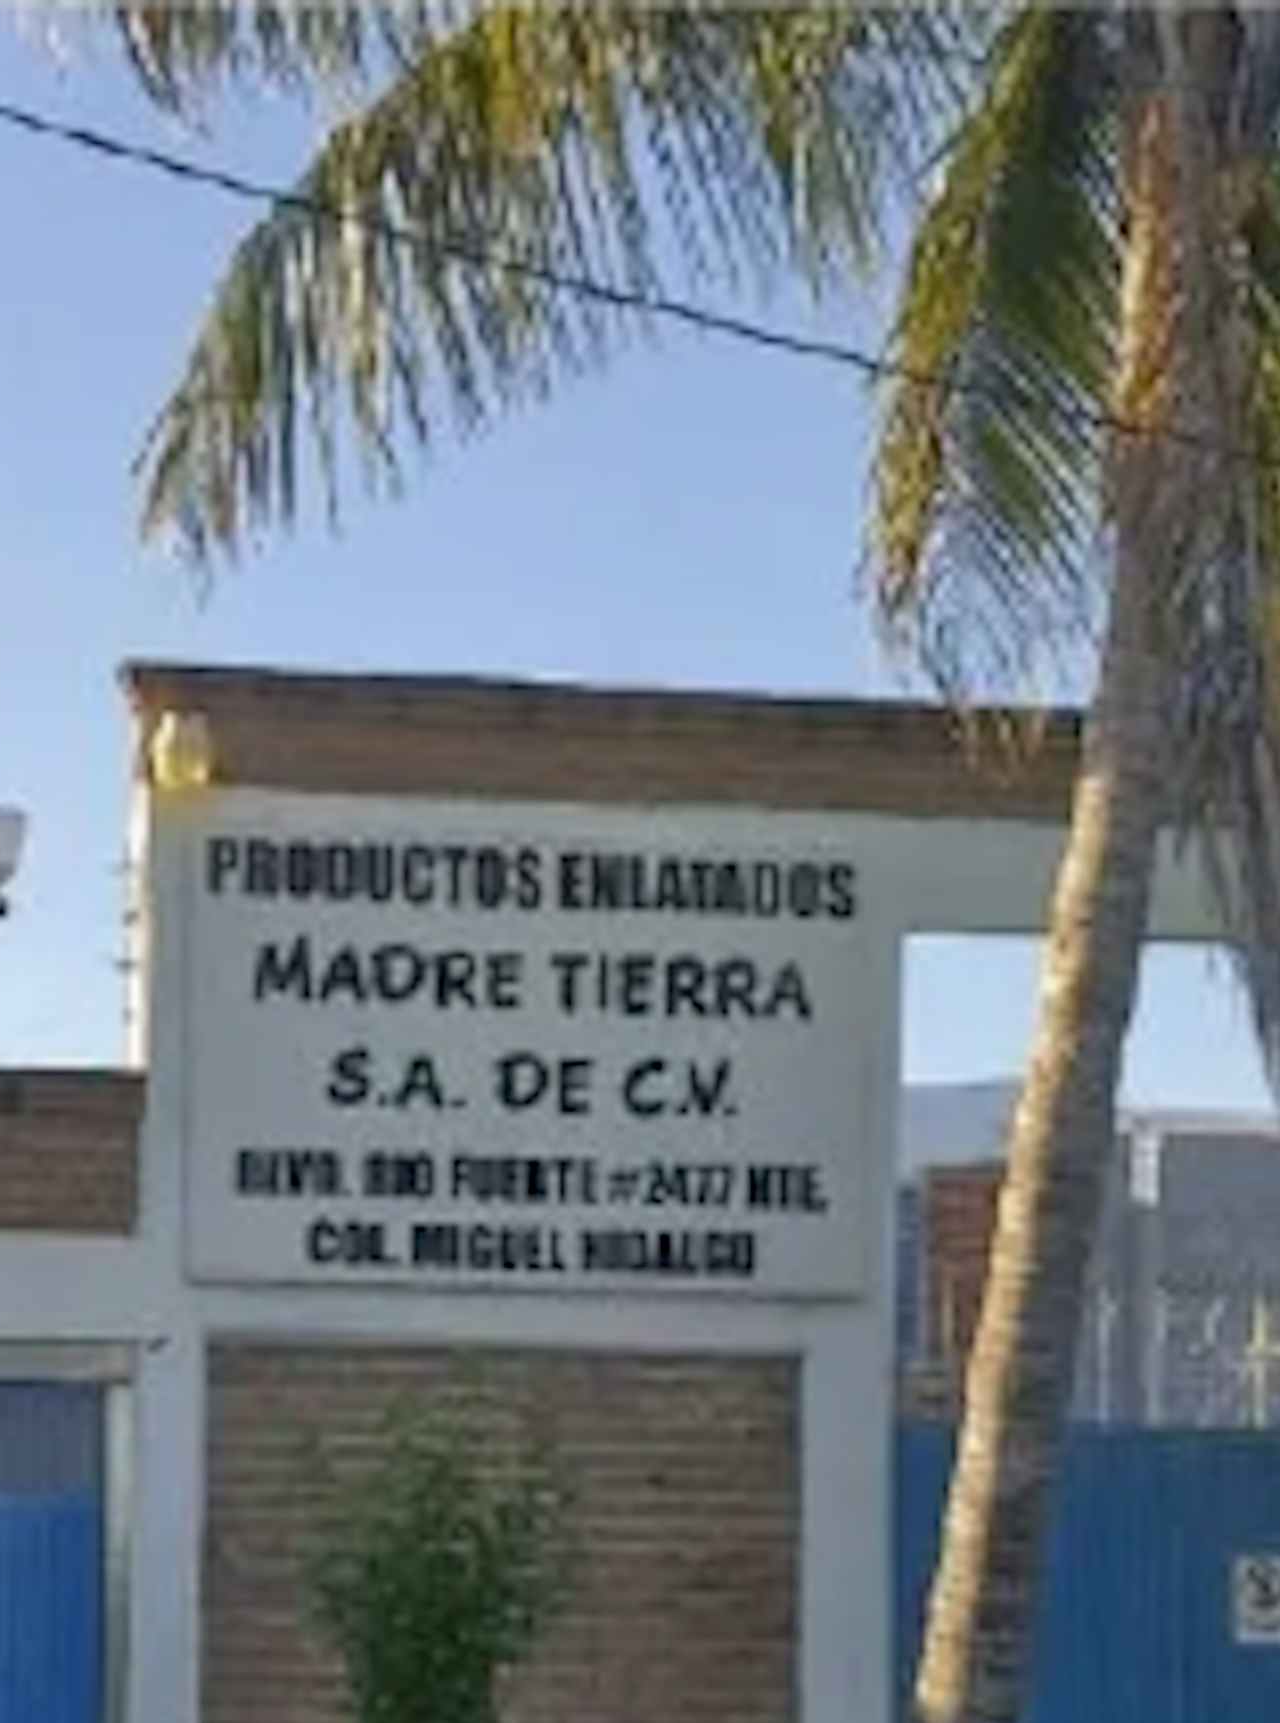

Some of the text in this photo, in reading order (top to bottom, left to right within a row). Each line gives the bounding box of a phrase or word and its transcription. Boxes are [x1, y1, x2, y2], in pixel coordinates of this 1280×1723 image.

[207, 837, 857, 921] PRODUCTOS ENLATADOS
[255, 936, 814, 1019] MADRE TIERRA
[326, 1048, 738, 1117] S.A. DE C.V.
[306, 1217, 756, 1277] COL. MIGUEL HIDALGO
